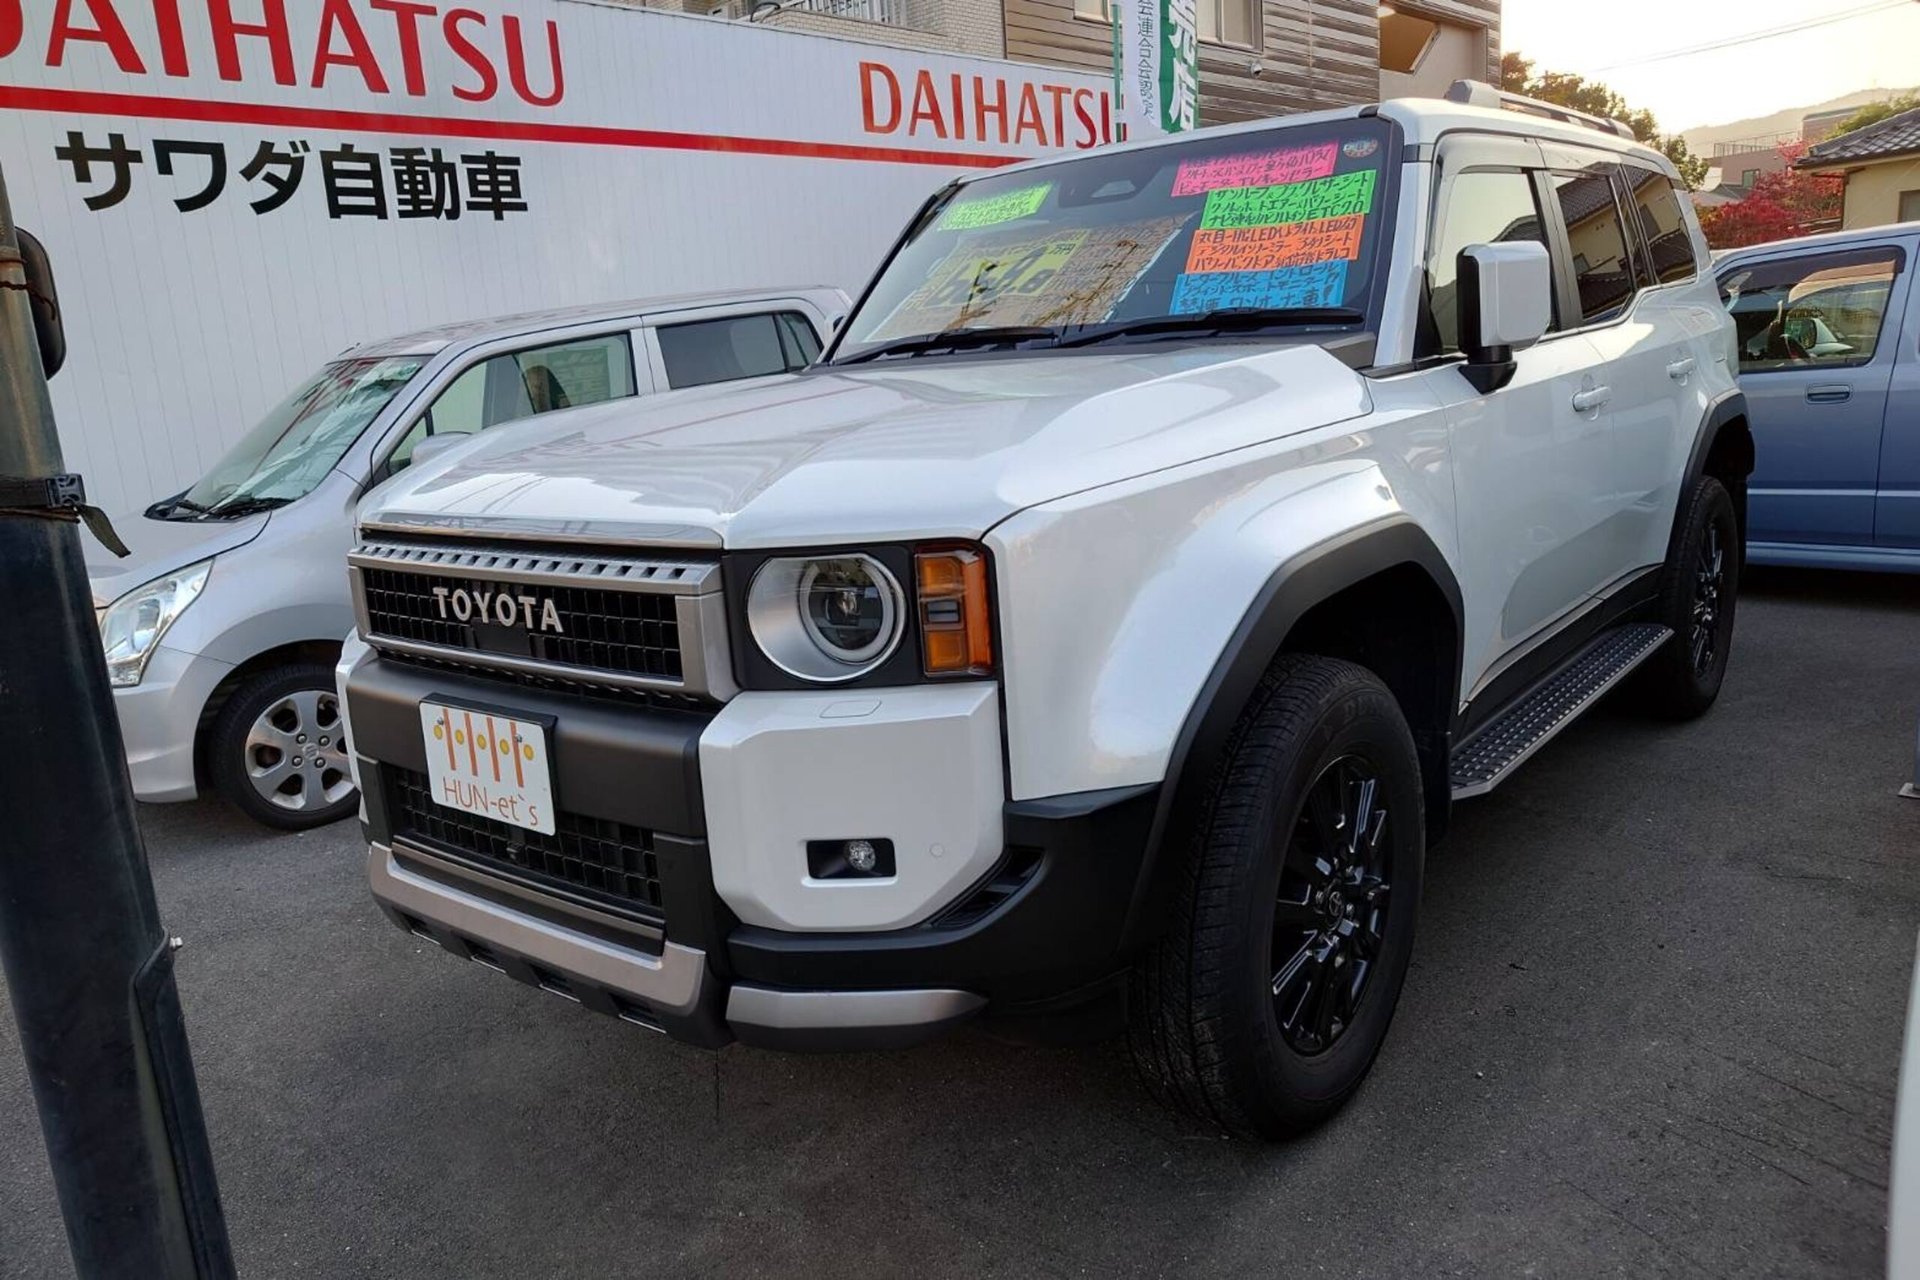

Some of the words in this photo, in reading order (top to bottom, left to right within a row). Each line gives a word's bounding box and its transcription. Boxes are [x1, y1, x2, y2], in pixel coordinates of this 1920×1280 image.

[0, 0, 565, 106] AIHATSU
[55, 131, 529, 221] サワダ自動車
[432, 587, 564, 633] TOYOTA
